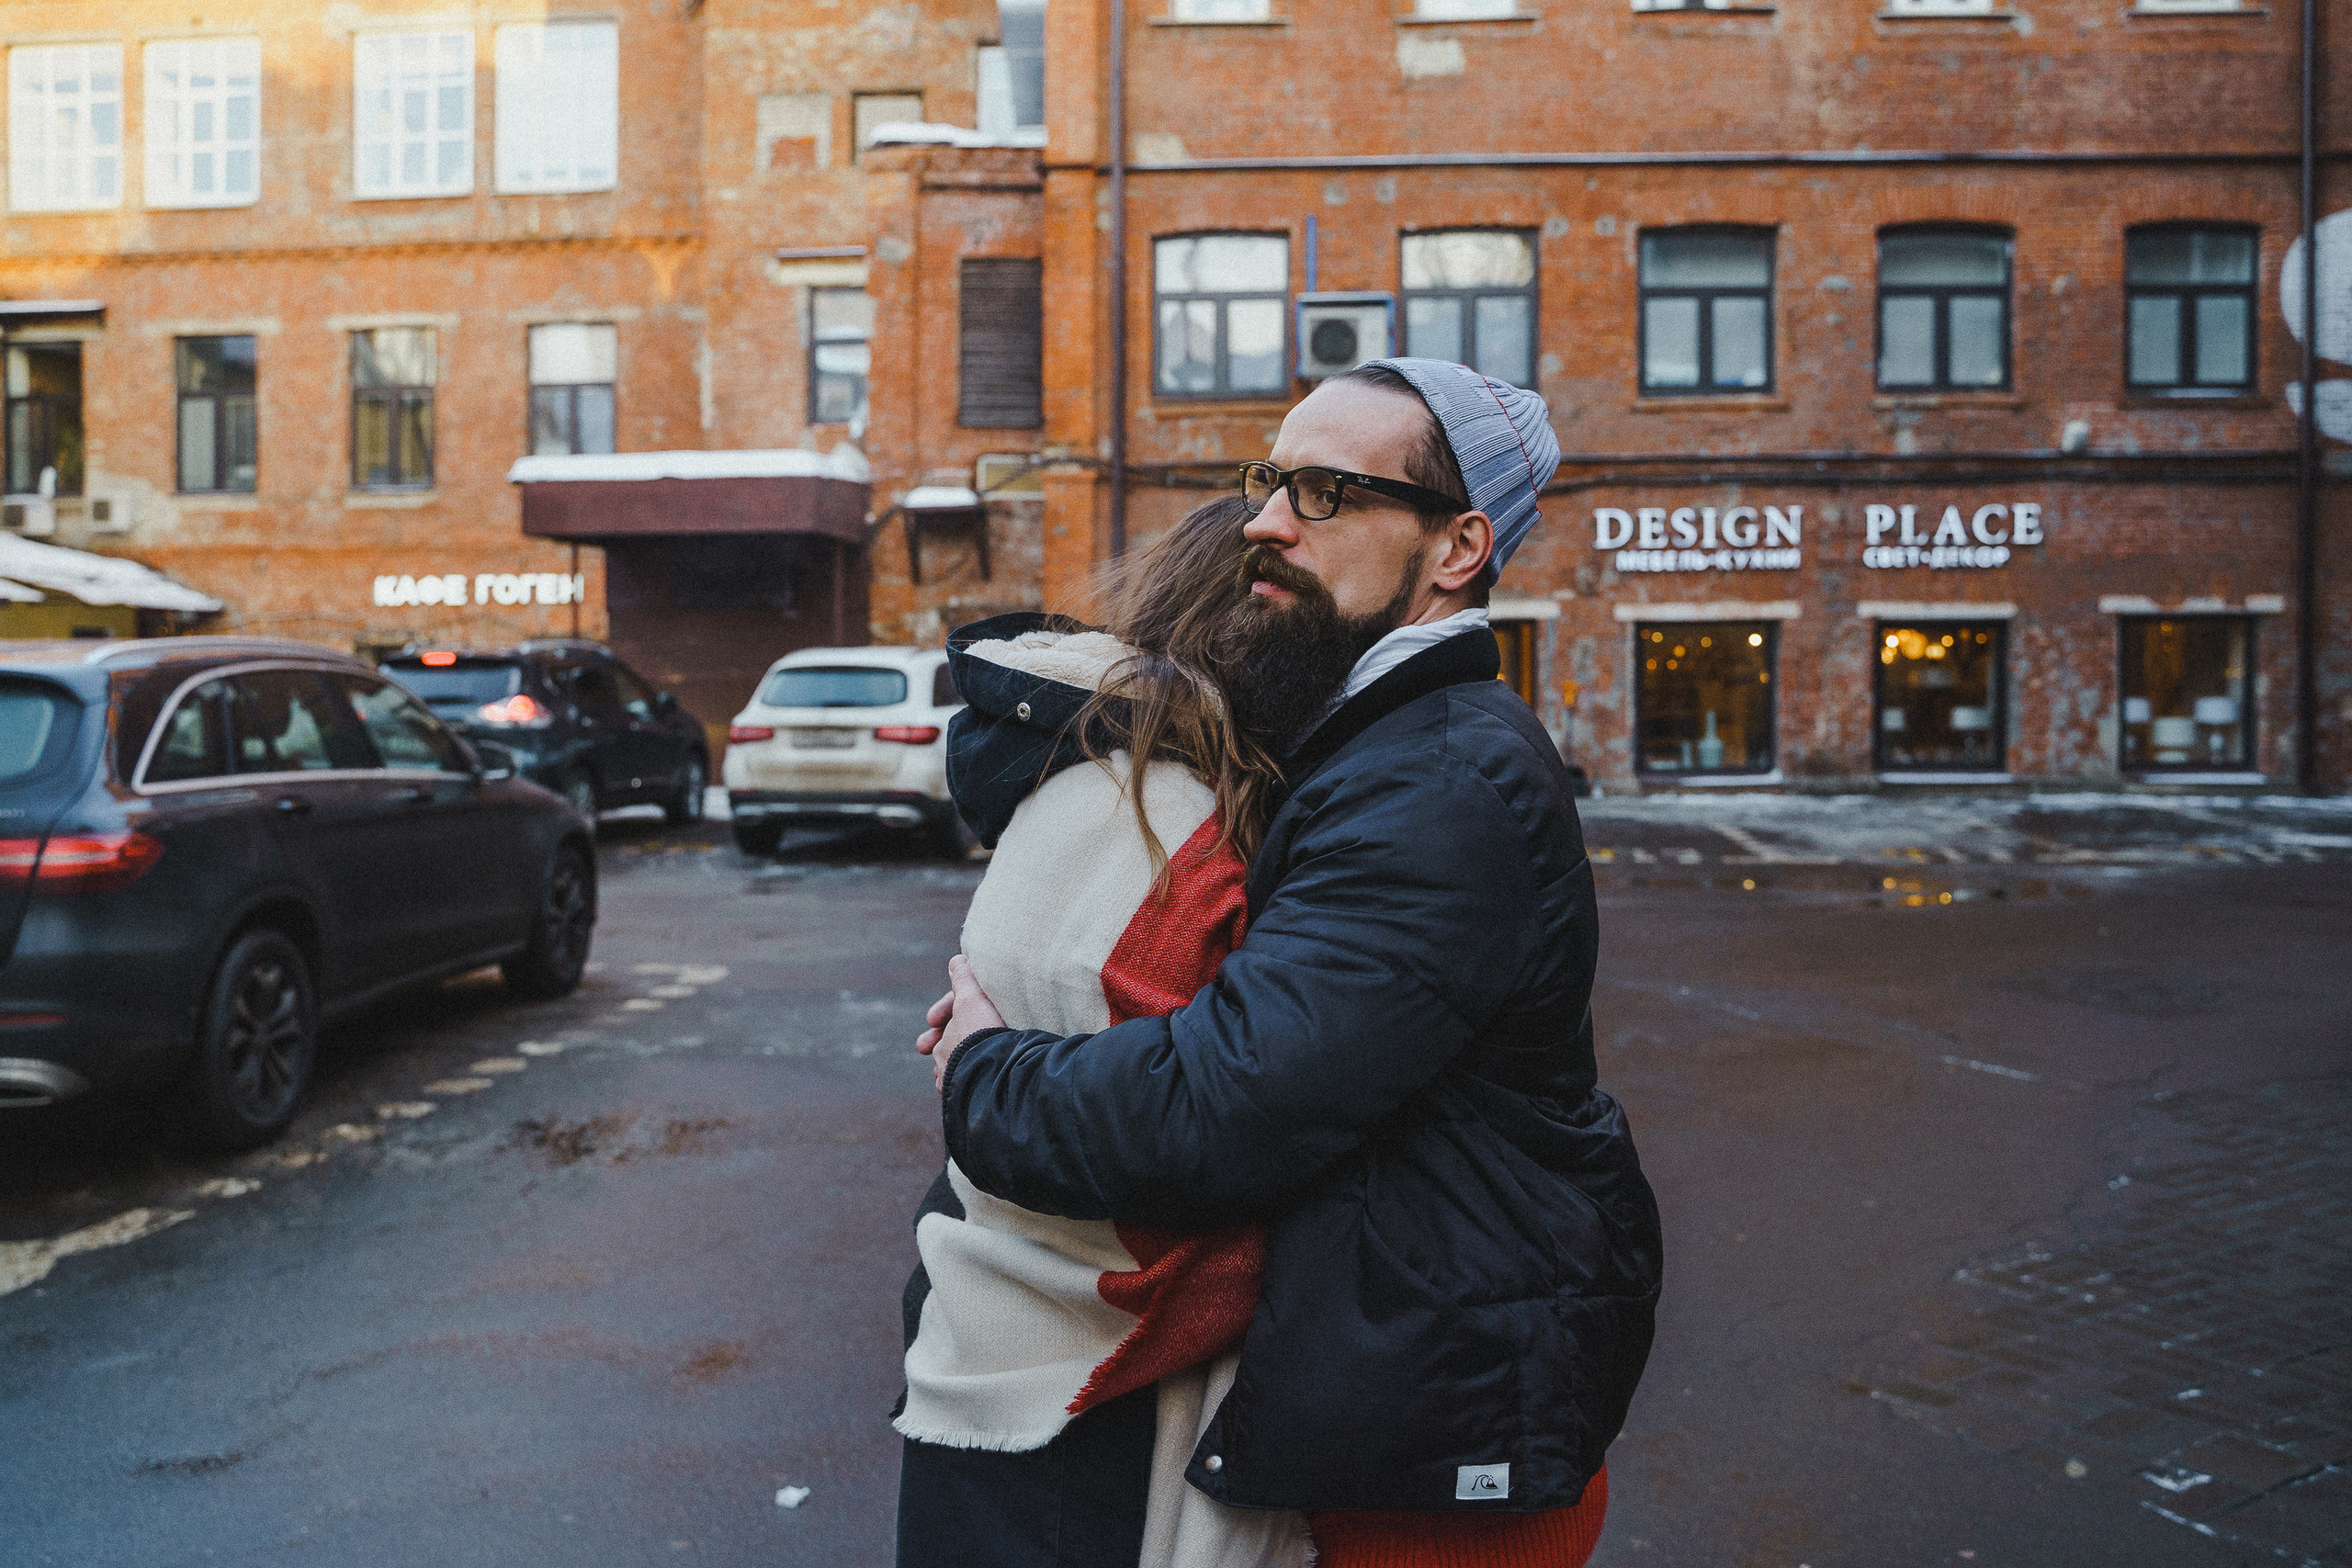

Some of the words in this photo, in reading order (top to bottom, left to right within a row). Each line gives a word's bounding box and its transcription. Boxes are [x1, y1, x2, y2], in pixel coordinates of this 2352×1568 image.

[1592, 506, 1802, 549] DESIGN
[1865, 502, 2044, 546] PLACE
[373, 574, 468, 606] КАФЕ
[474, 573, 584, 605] ГОГЕН
